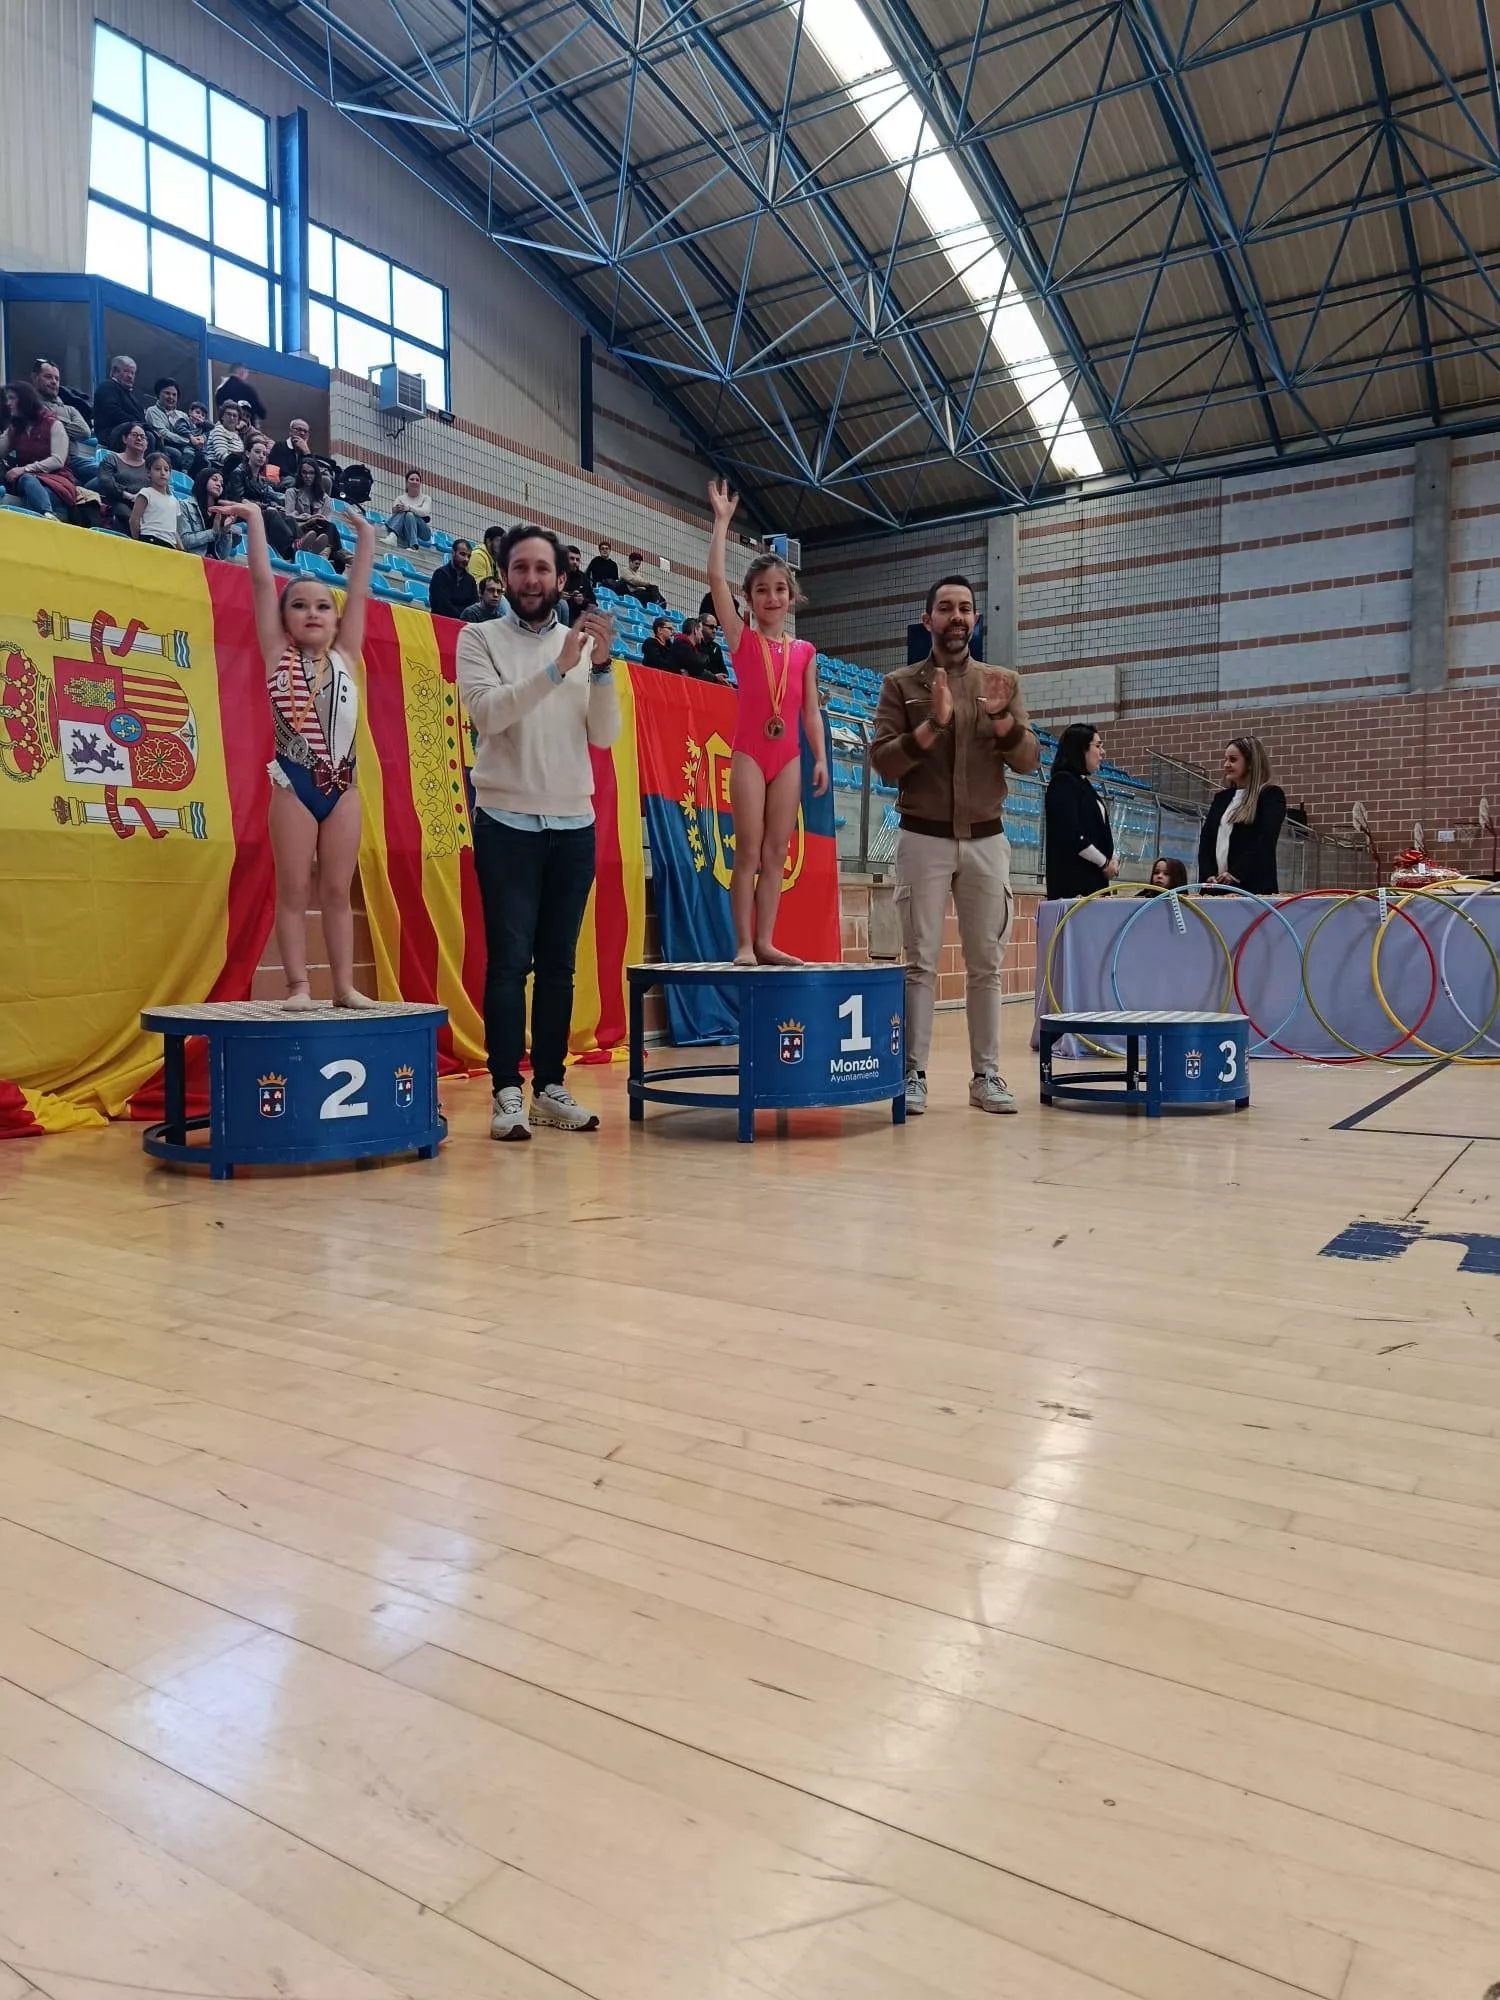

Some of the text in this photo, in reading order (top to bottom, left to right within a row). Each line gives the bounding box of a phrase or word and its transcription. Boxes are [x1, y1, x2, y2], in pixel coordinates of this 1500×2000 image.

[839, 995, 871, 1052] 1
[830, 1056, 879, 1073] Monzón
[831, 1071, 879, 1083] Ayuntamiento
[1219, 1040, 1236, 1082] 3
[320, 1059, 368, 1119] 2
